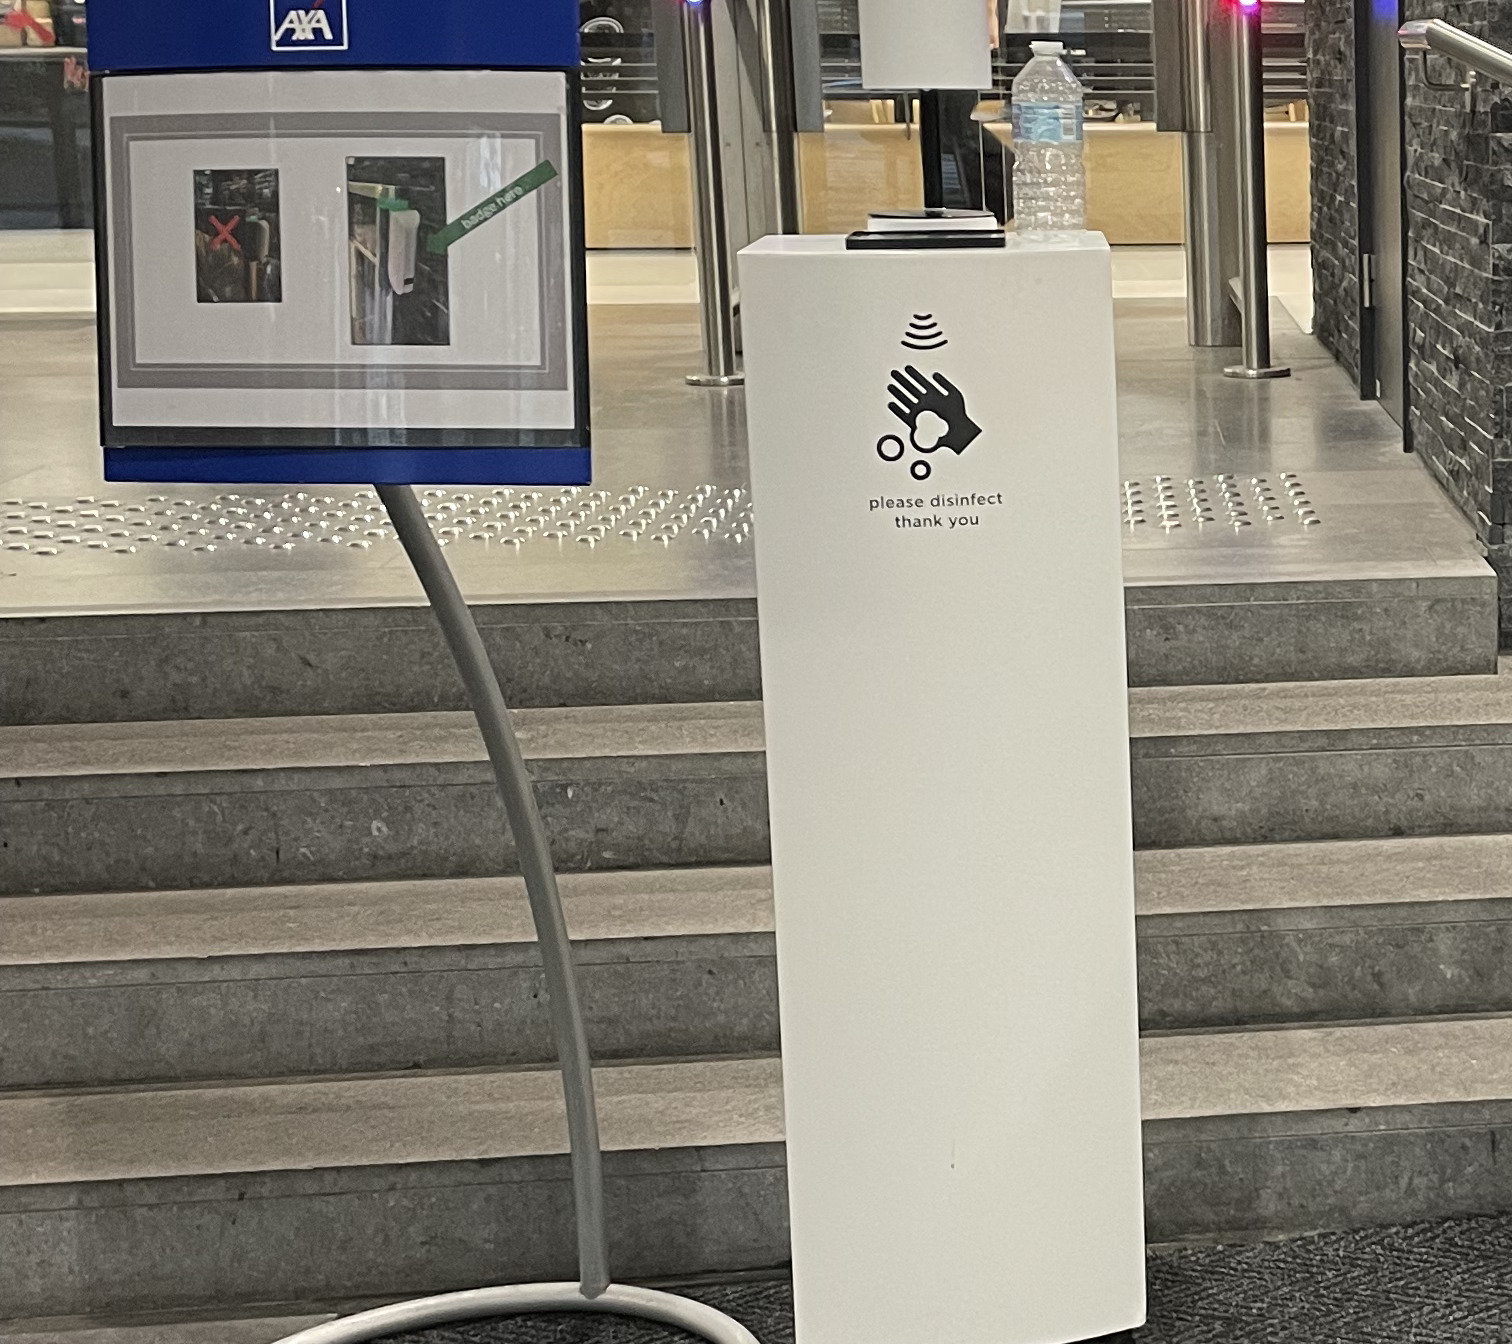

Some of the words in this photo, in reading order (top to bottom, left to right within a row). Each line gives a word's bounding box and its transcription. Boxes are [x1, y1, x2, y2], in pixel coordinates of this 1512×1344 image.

[275, 9, 334, 41] AXA
[461, 202, 498, 229] badge
[869, 495, 924, 511] please
[930, 492, 1003, 507] disinfect
[895, 514, 943, 529] thank
[948, 515, 979, 529] you
